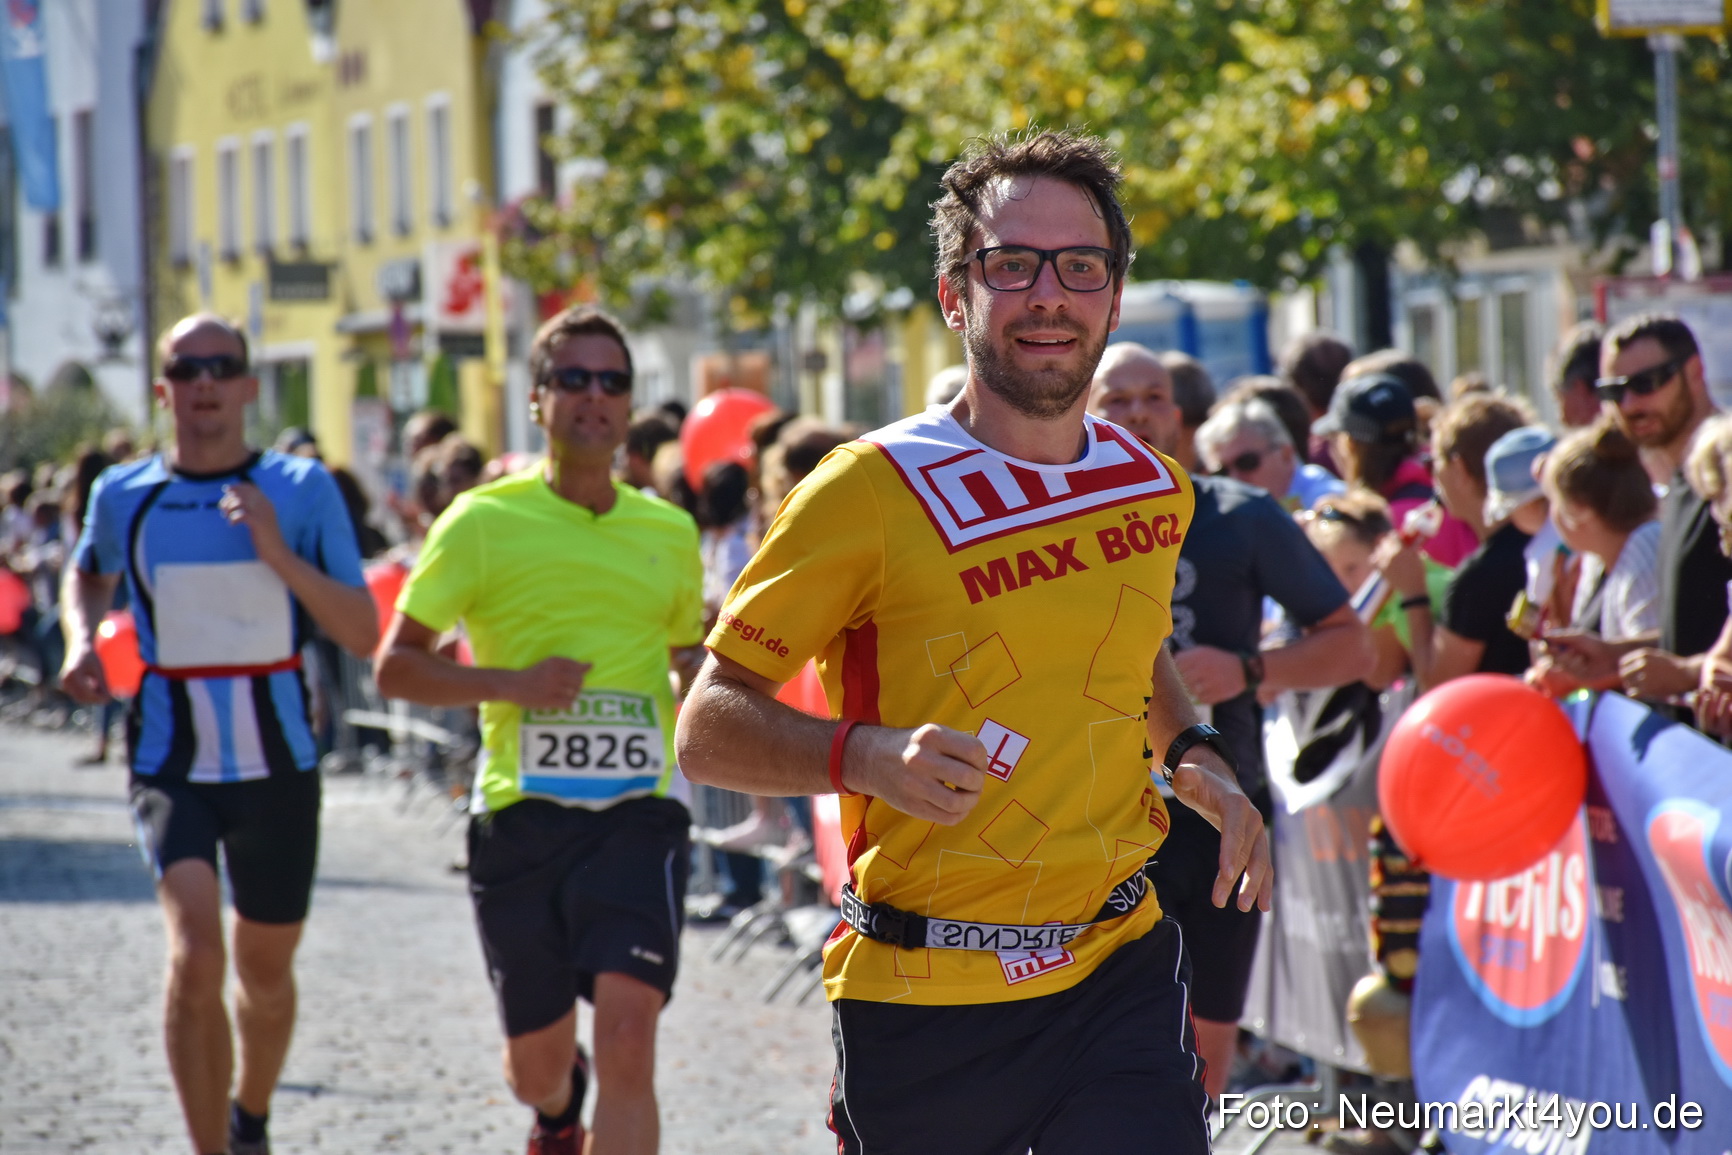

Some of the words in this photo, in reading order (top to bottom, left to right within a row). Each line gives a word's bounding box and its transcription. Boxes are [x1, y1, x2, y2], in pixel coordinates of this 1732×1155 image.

[958, 537, 1090, 605] MAX
[1095, 511, 1182, 564] BÖGL
[531, 692, 648, 725] OCK
[537, 732, 649, 770] 2826
